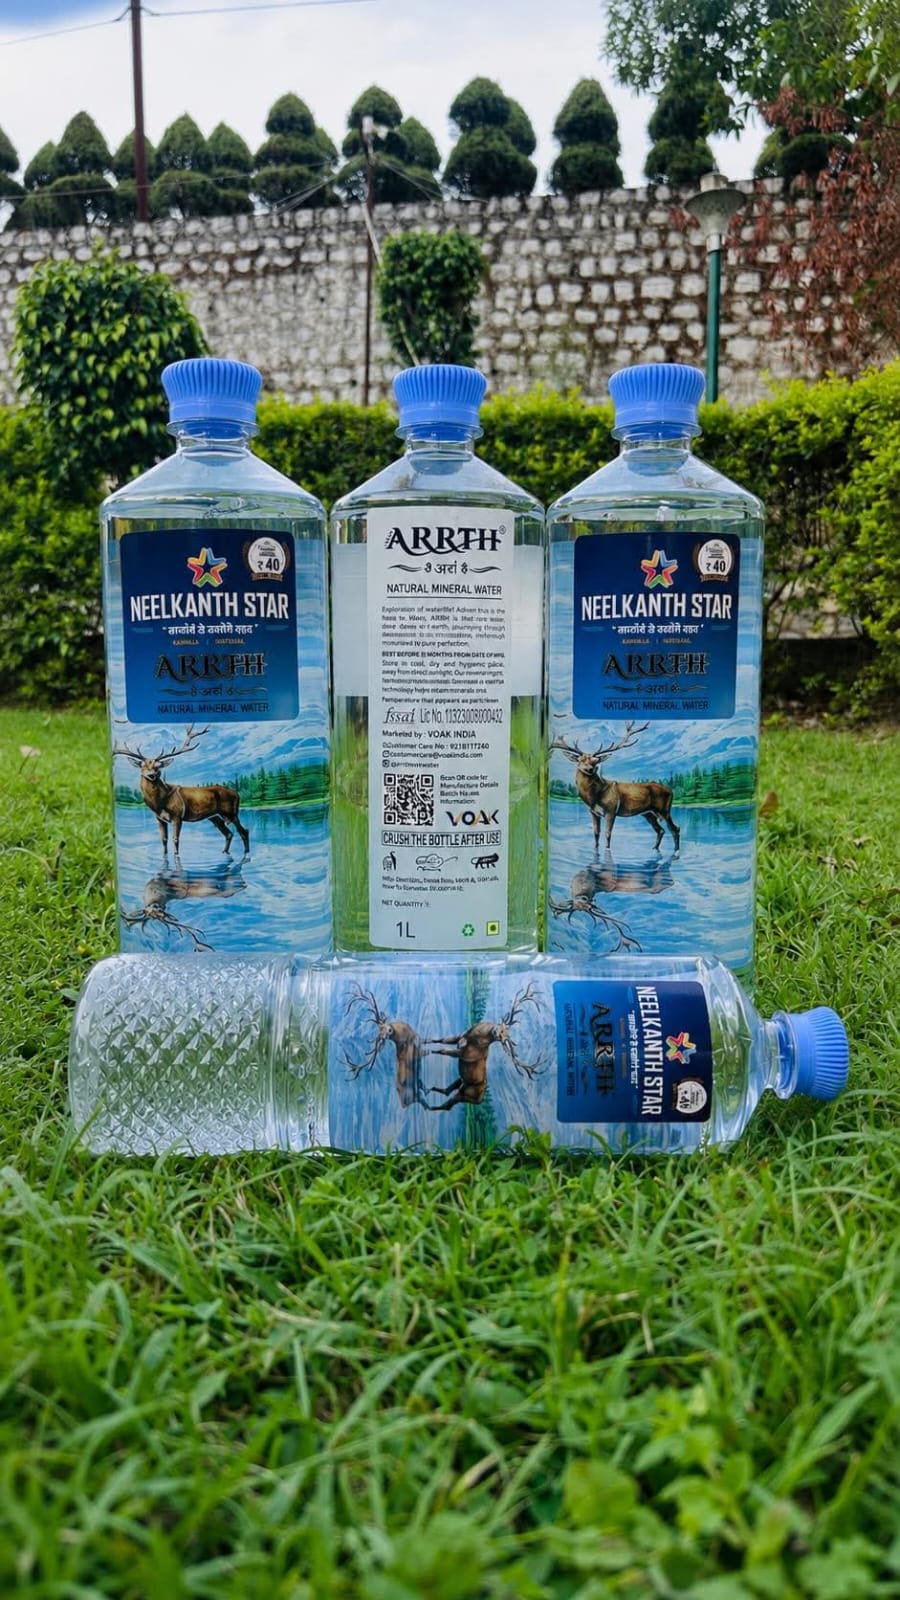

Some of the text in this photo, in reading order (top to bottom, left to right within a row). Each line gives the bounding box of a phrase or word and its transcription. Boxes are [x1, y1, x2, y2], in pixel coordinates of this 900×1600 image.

[385, 526, 502, 556] ARRTH
[266, 558, 280, 571] 40
[713, 560, 726, 573] 40
[387, 583, 502, 595] NATURAL MINERAL WATER
[130, 592, 289, 622] NEELKANTH STAR
[581, 593, 732, 621] NEELKANTH STAR
[603, 652, 710, 681] ARRTH
[157, 702, 270, 714] NATURAL MINERAL WATER
[603, 699, 709, 711] NATURAL MINERAL WATER
[382, 706, 416, 724] fssai
[382, 729, 413, 738] Marketed
[414, 731, 423, 740] by
[427, 730, 452, 738] VOAK
[453, 730, 476, 739] INDIA
[445, 809, 500, 827] VOAK
[383, 831, 500, 846] CRUSH THE BOTTLE AFTER USE
[394, 900, 424, 908] QUANTITY
[396, 920, 416, 939] 1L
[635, 986, 664, 1115] NEELKANTH STAR
